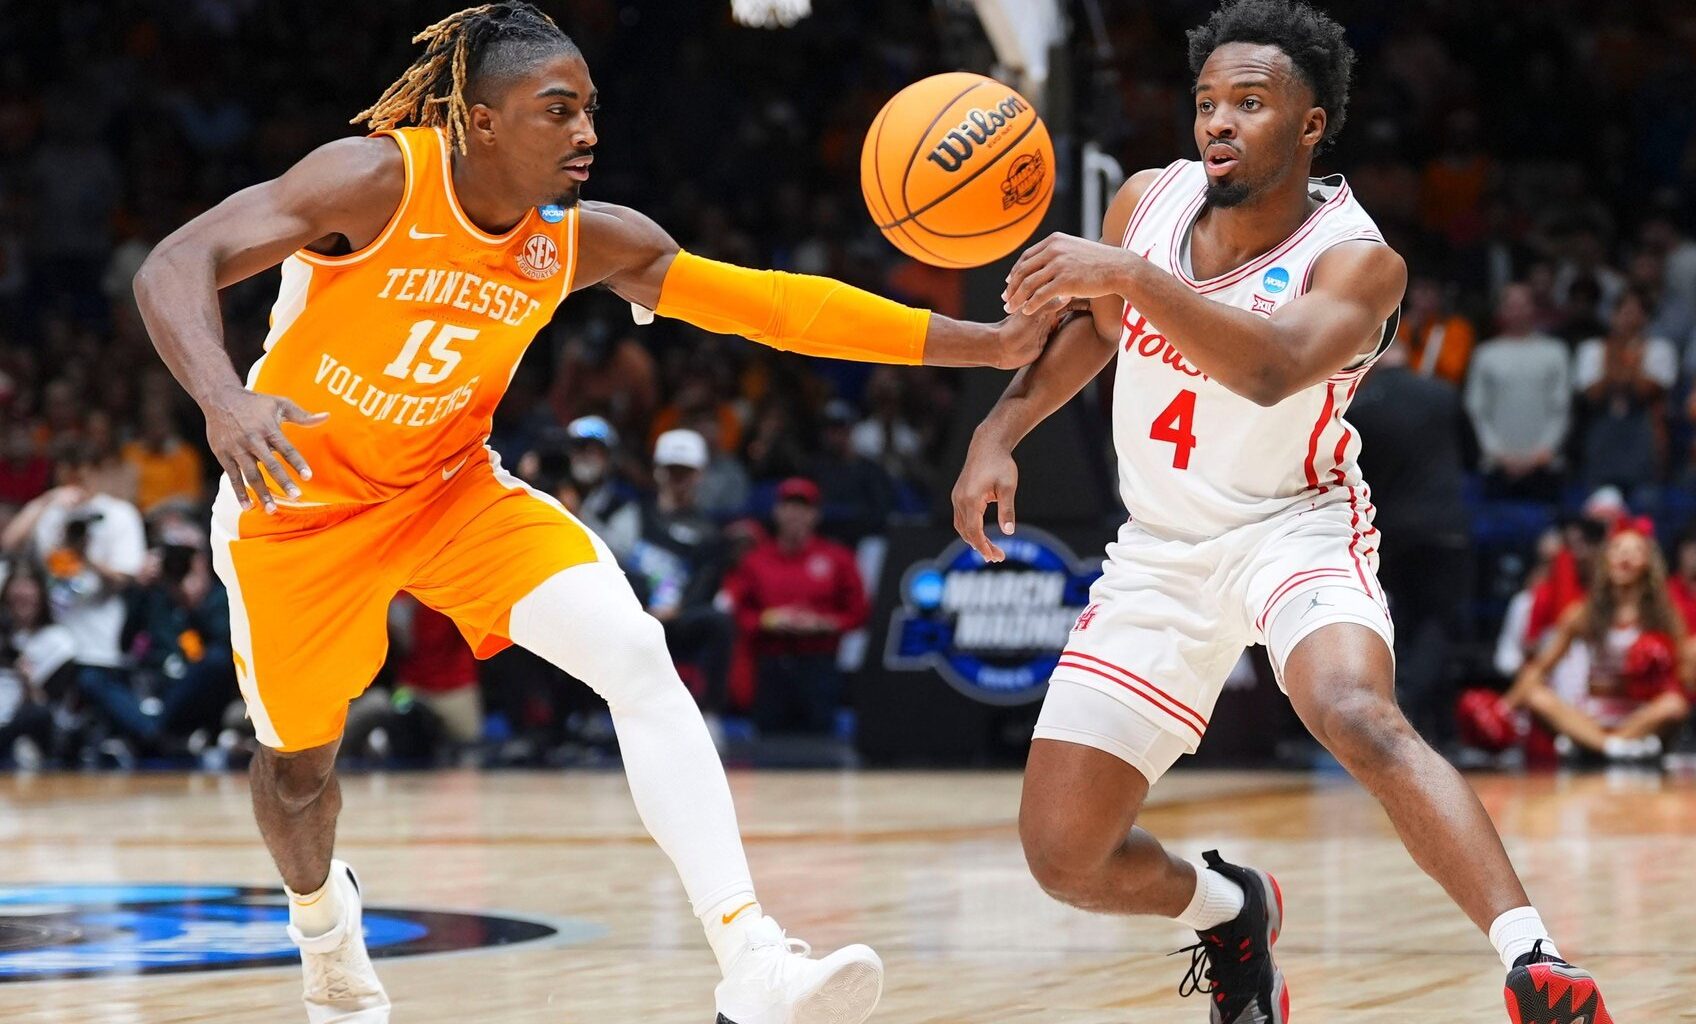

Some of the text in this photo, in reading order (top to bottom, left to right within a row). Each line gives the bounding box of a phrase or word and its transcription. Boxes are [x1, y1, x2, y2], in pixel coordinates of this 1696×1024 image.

[926, 95, 1028, 173] Wilson
[541, 209, 564, 218] NCAA
[525, 236, 556, 270] SEC
[1264, 276, 1288, 289] NCAA
[377, 268, 541, 326] TENNESSEE
[383, 319, 480, 384] 15
[314, 353, 480, 427] VOLUNTEERS
[1150, 388, 1197, 470] 4
